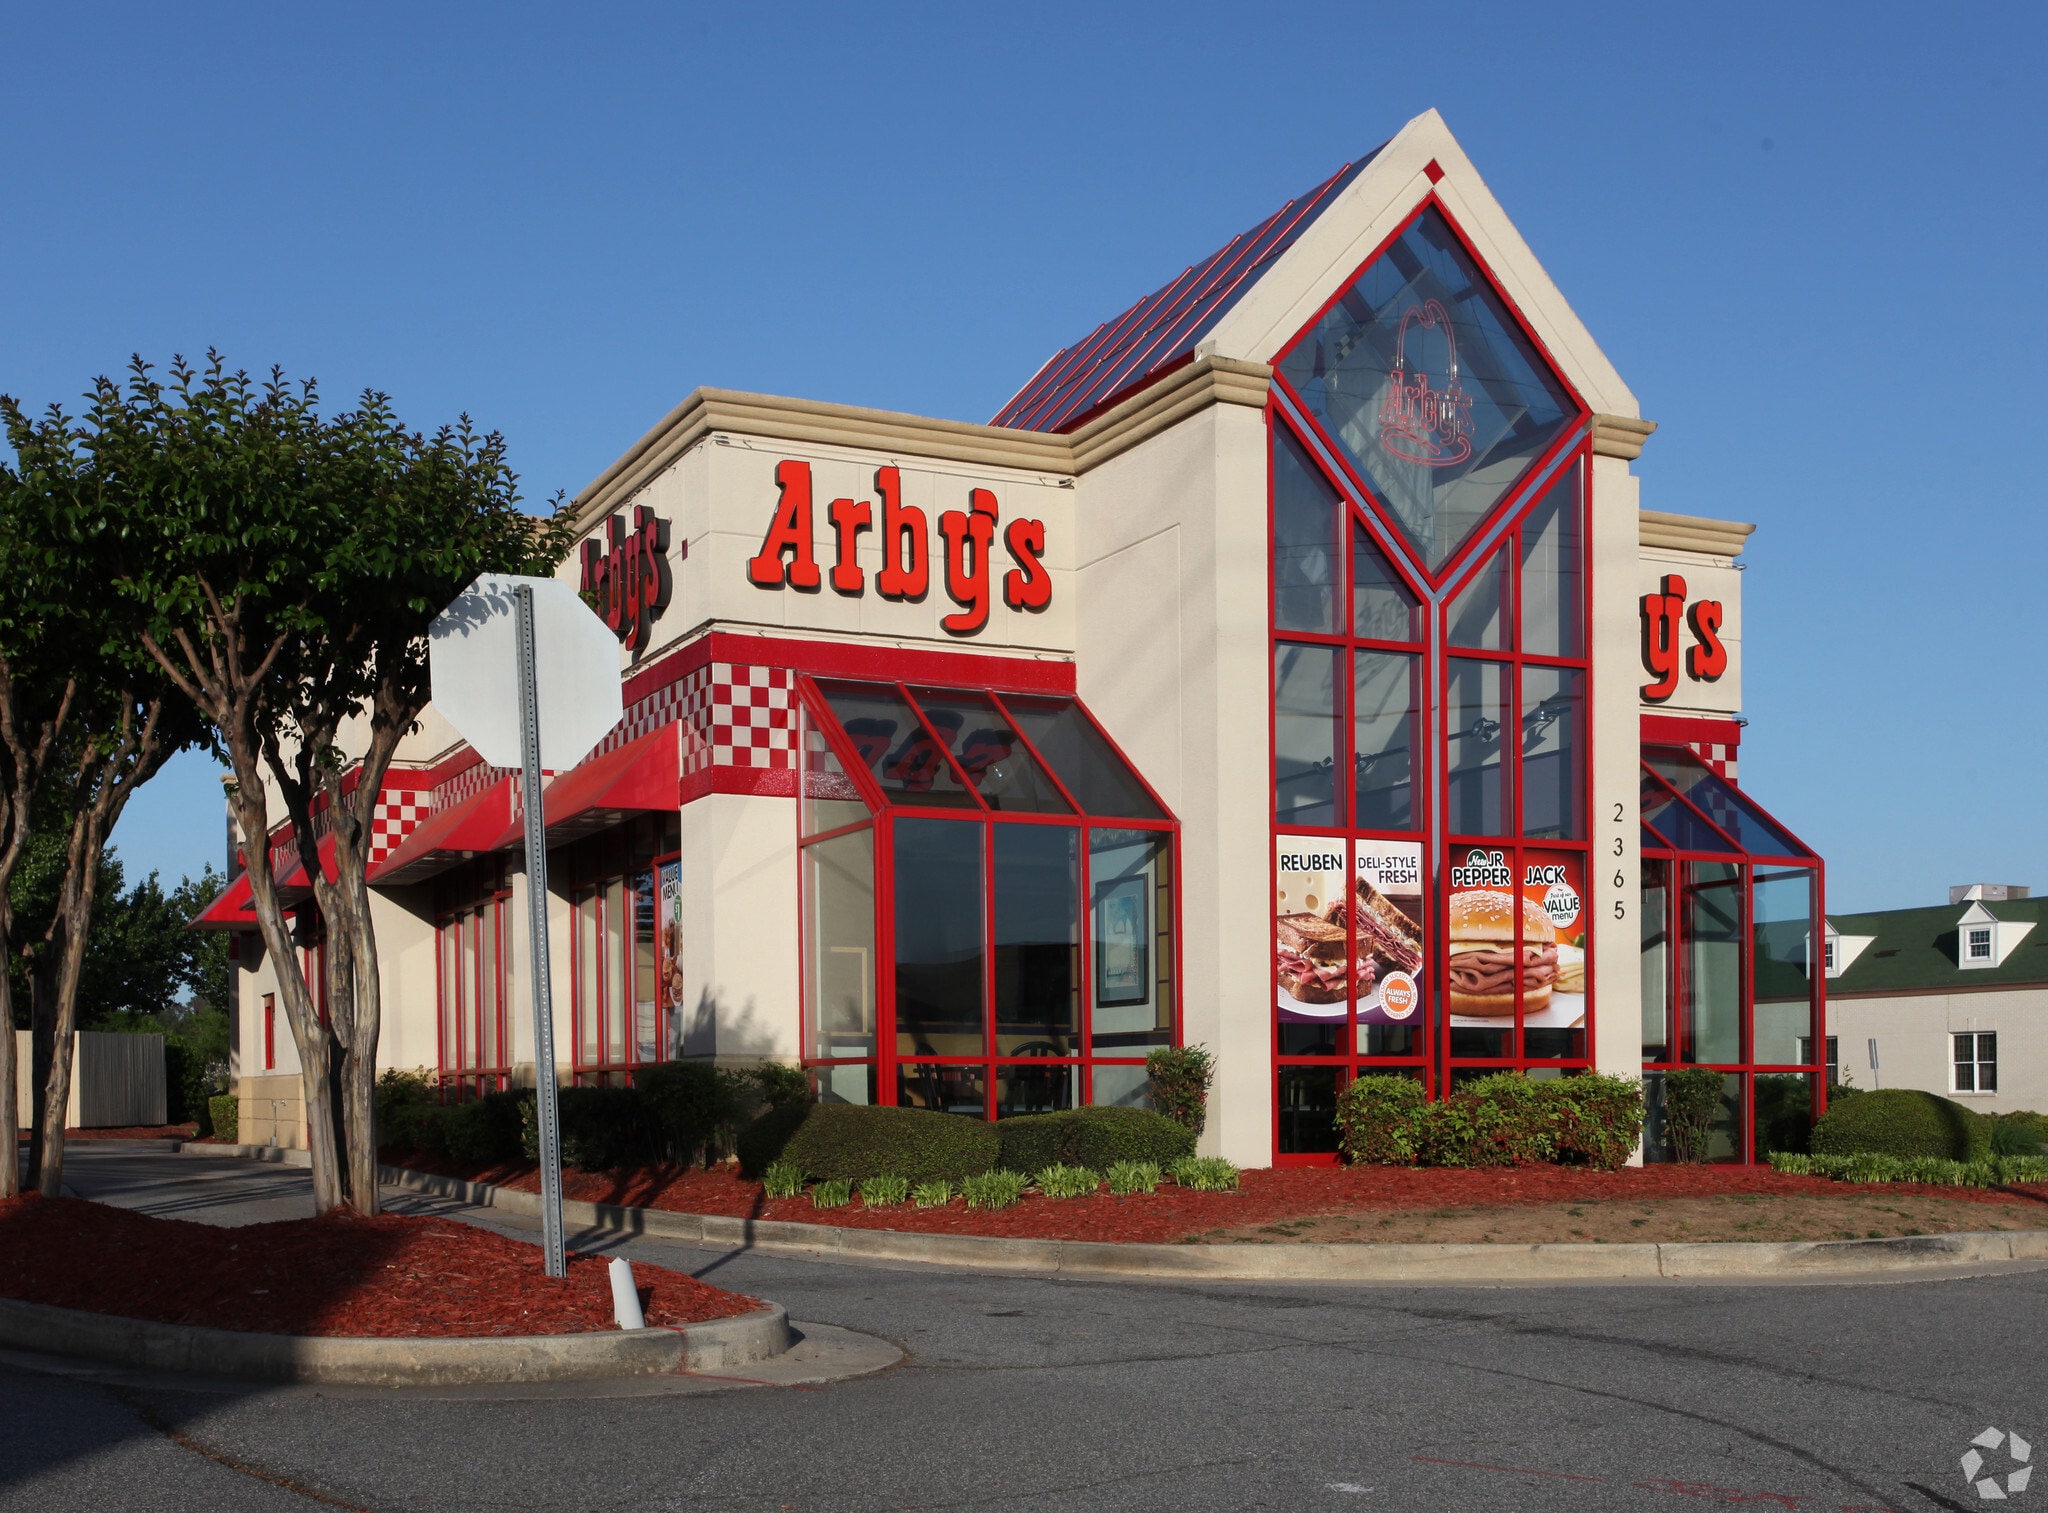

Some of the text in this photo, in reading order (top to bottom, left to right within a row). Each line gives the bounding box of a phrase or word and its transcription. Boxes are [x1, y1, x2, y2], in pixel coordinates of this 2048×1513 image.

[1379, 370, 1475, 446] Arby's
[747, 459, 1051, 634] Arby's
[1641, 574, 1727, 703] y's
[1280, 854, 1343, 871] REUBEN
[1358, 856, 1417, 869] DELI-STYLE
[1468, 852, 1503, 867] New JR
[1378, 870, 1418, 883] FRESH
[1452, 866, 1566, 886] PEPPER JACK
[1543, 897, 1580, 913] VALUE
[1551, 911, 1574, 921] menu
[1386, 988, 1410, 998] ALWAYS
[1387, 996, 1408, 1005] FRESH
